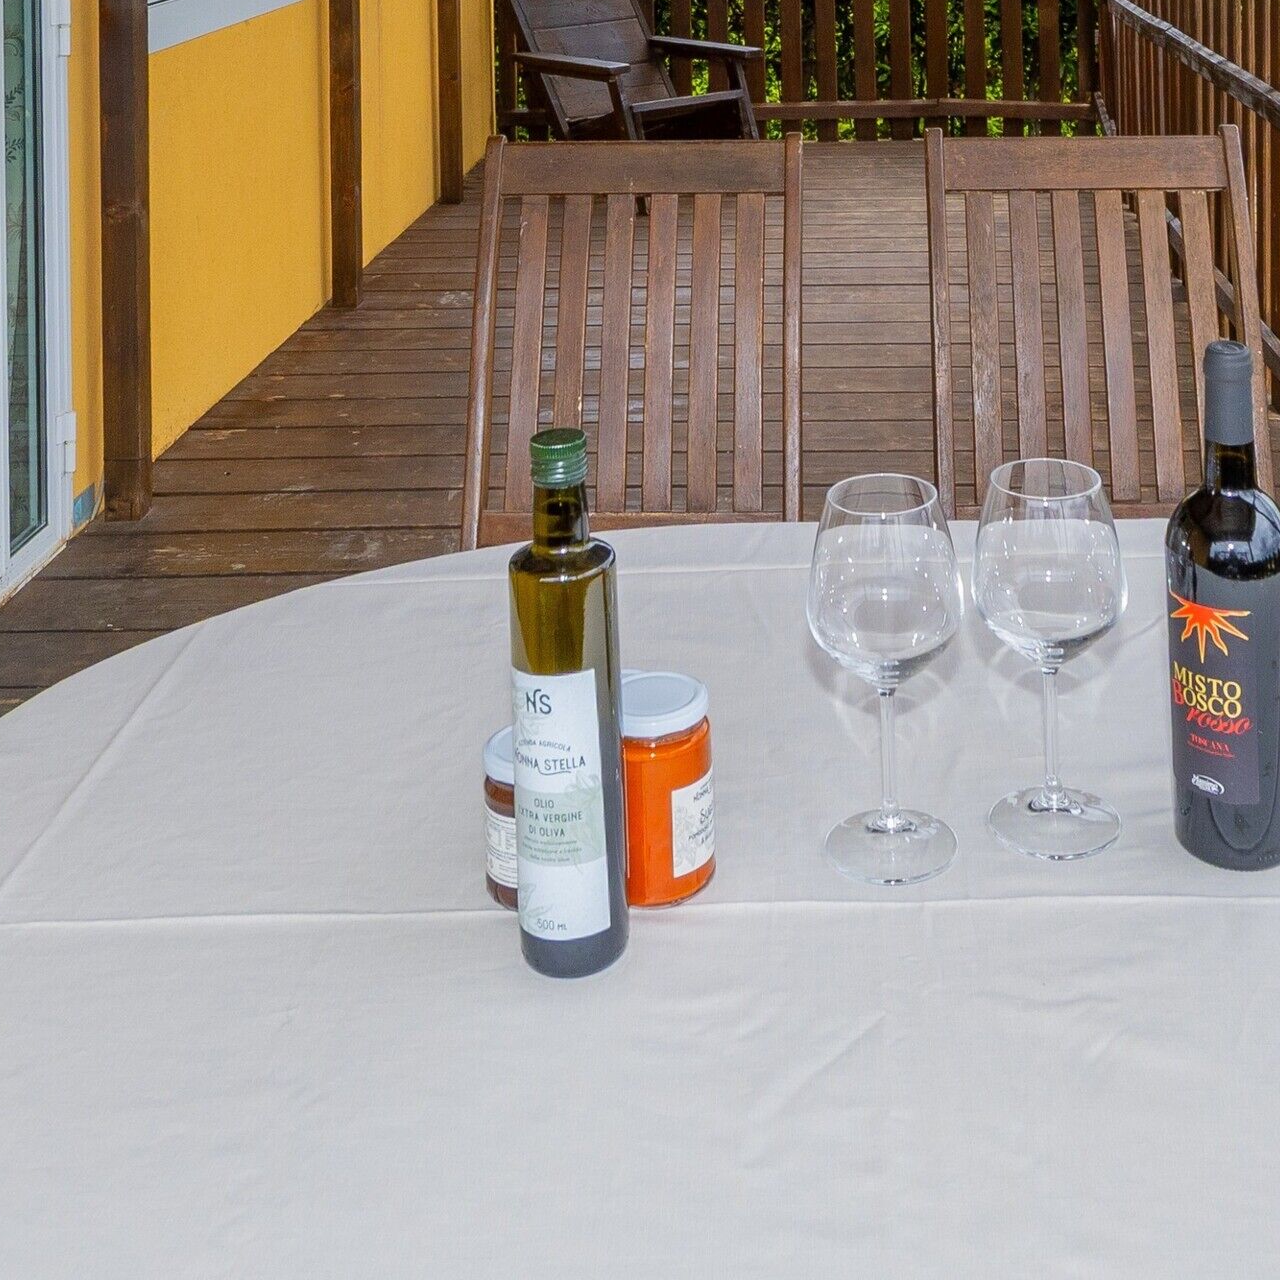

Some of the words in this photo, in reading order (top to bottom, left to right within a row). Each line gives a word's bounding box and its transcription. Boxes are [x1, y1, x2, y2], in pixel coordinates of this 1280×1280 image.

[1173, 660, 1242, 700] MISTO
[1172, 678, 1242, 718] BOSCO
[538, 740, 572, 752] AGRICOLA
[543, 755, 587, 771] STELLA
[533, 798, 555, 809] OLIO
[543, 811, 583, 823] VERGINE
[528, 824, 537, 835] DI
[539, 827, 566, 837] OLIVA
[536, 918, 555, 931] 500
